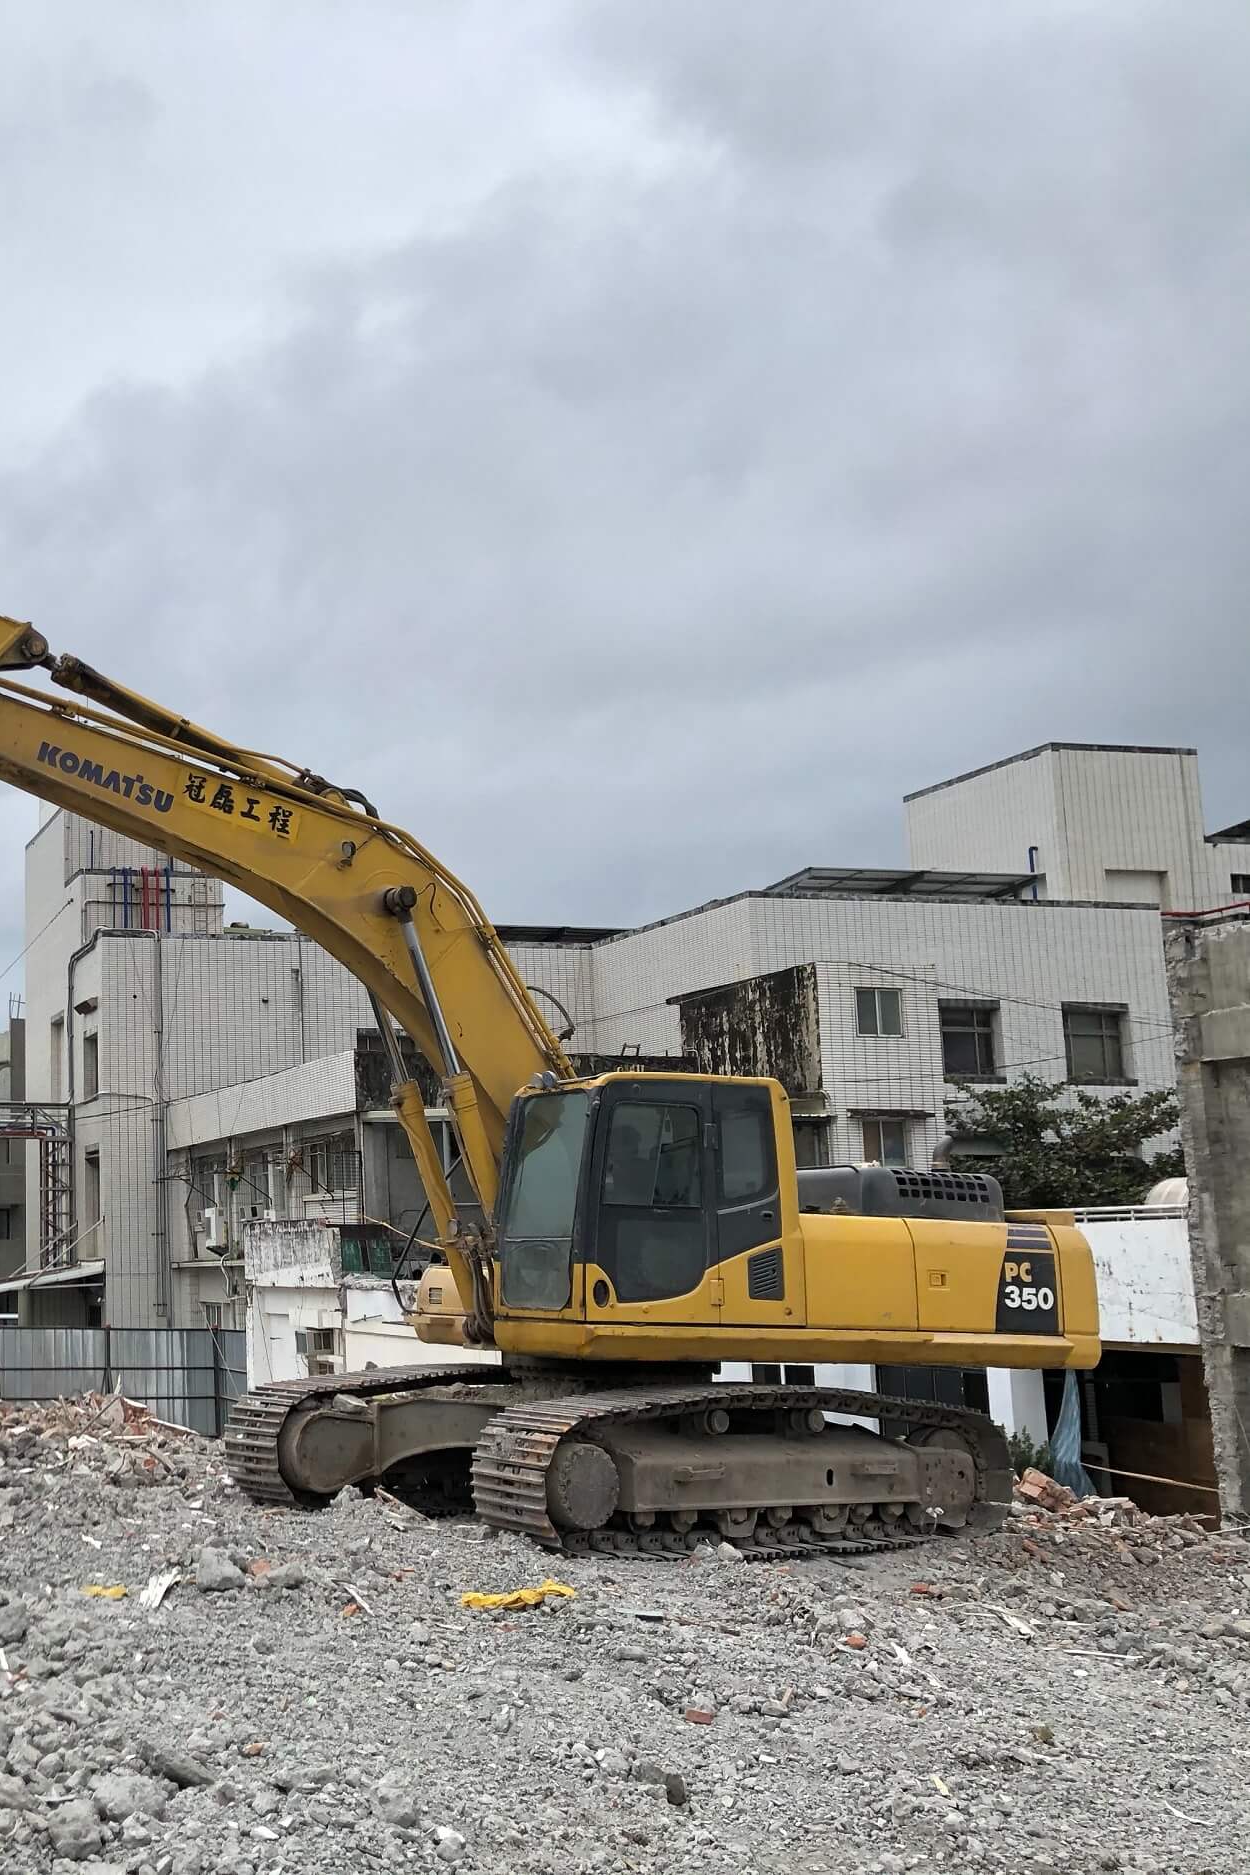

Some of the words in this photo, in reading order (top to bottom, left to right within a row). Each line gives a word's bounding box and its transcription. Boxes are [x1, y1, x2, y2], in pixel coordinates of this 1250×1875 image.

[37, 741, 175, 813] KOMATSU
[184, 772, 294, 840] 冠磊工程
[1004, 1262, 1033, 1283] PC
[1004, 1285, 1054, 1310] 350
